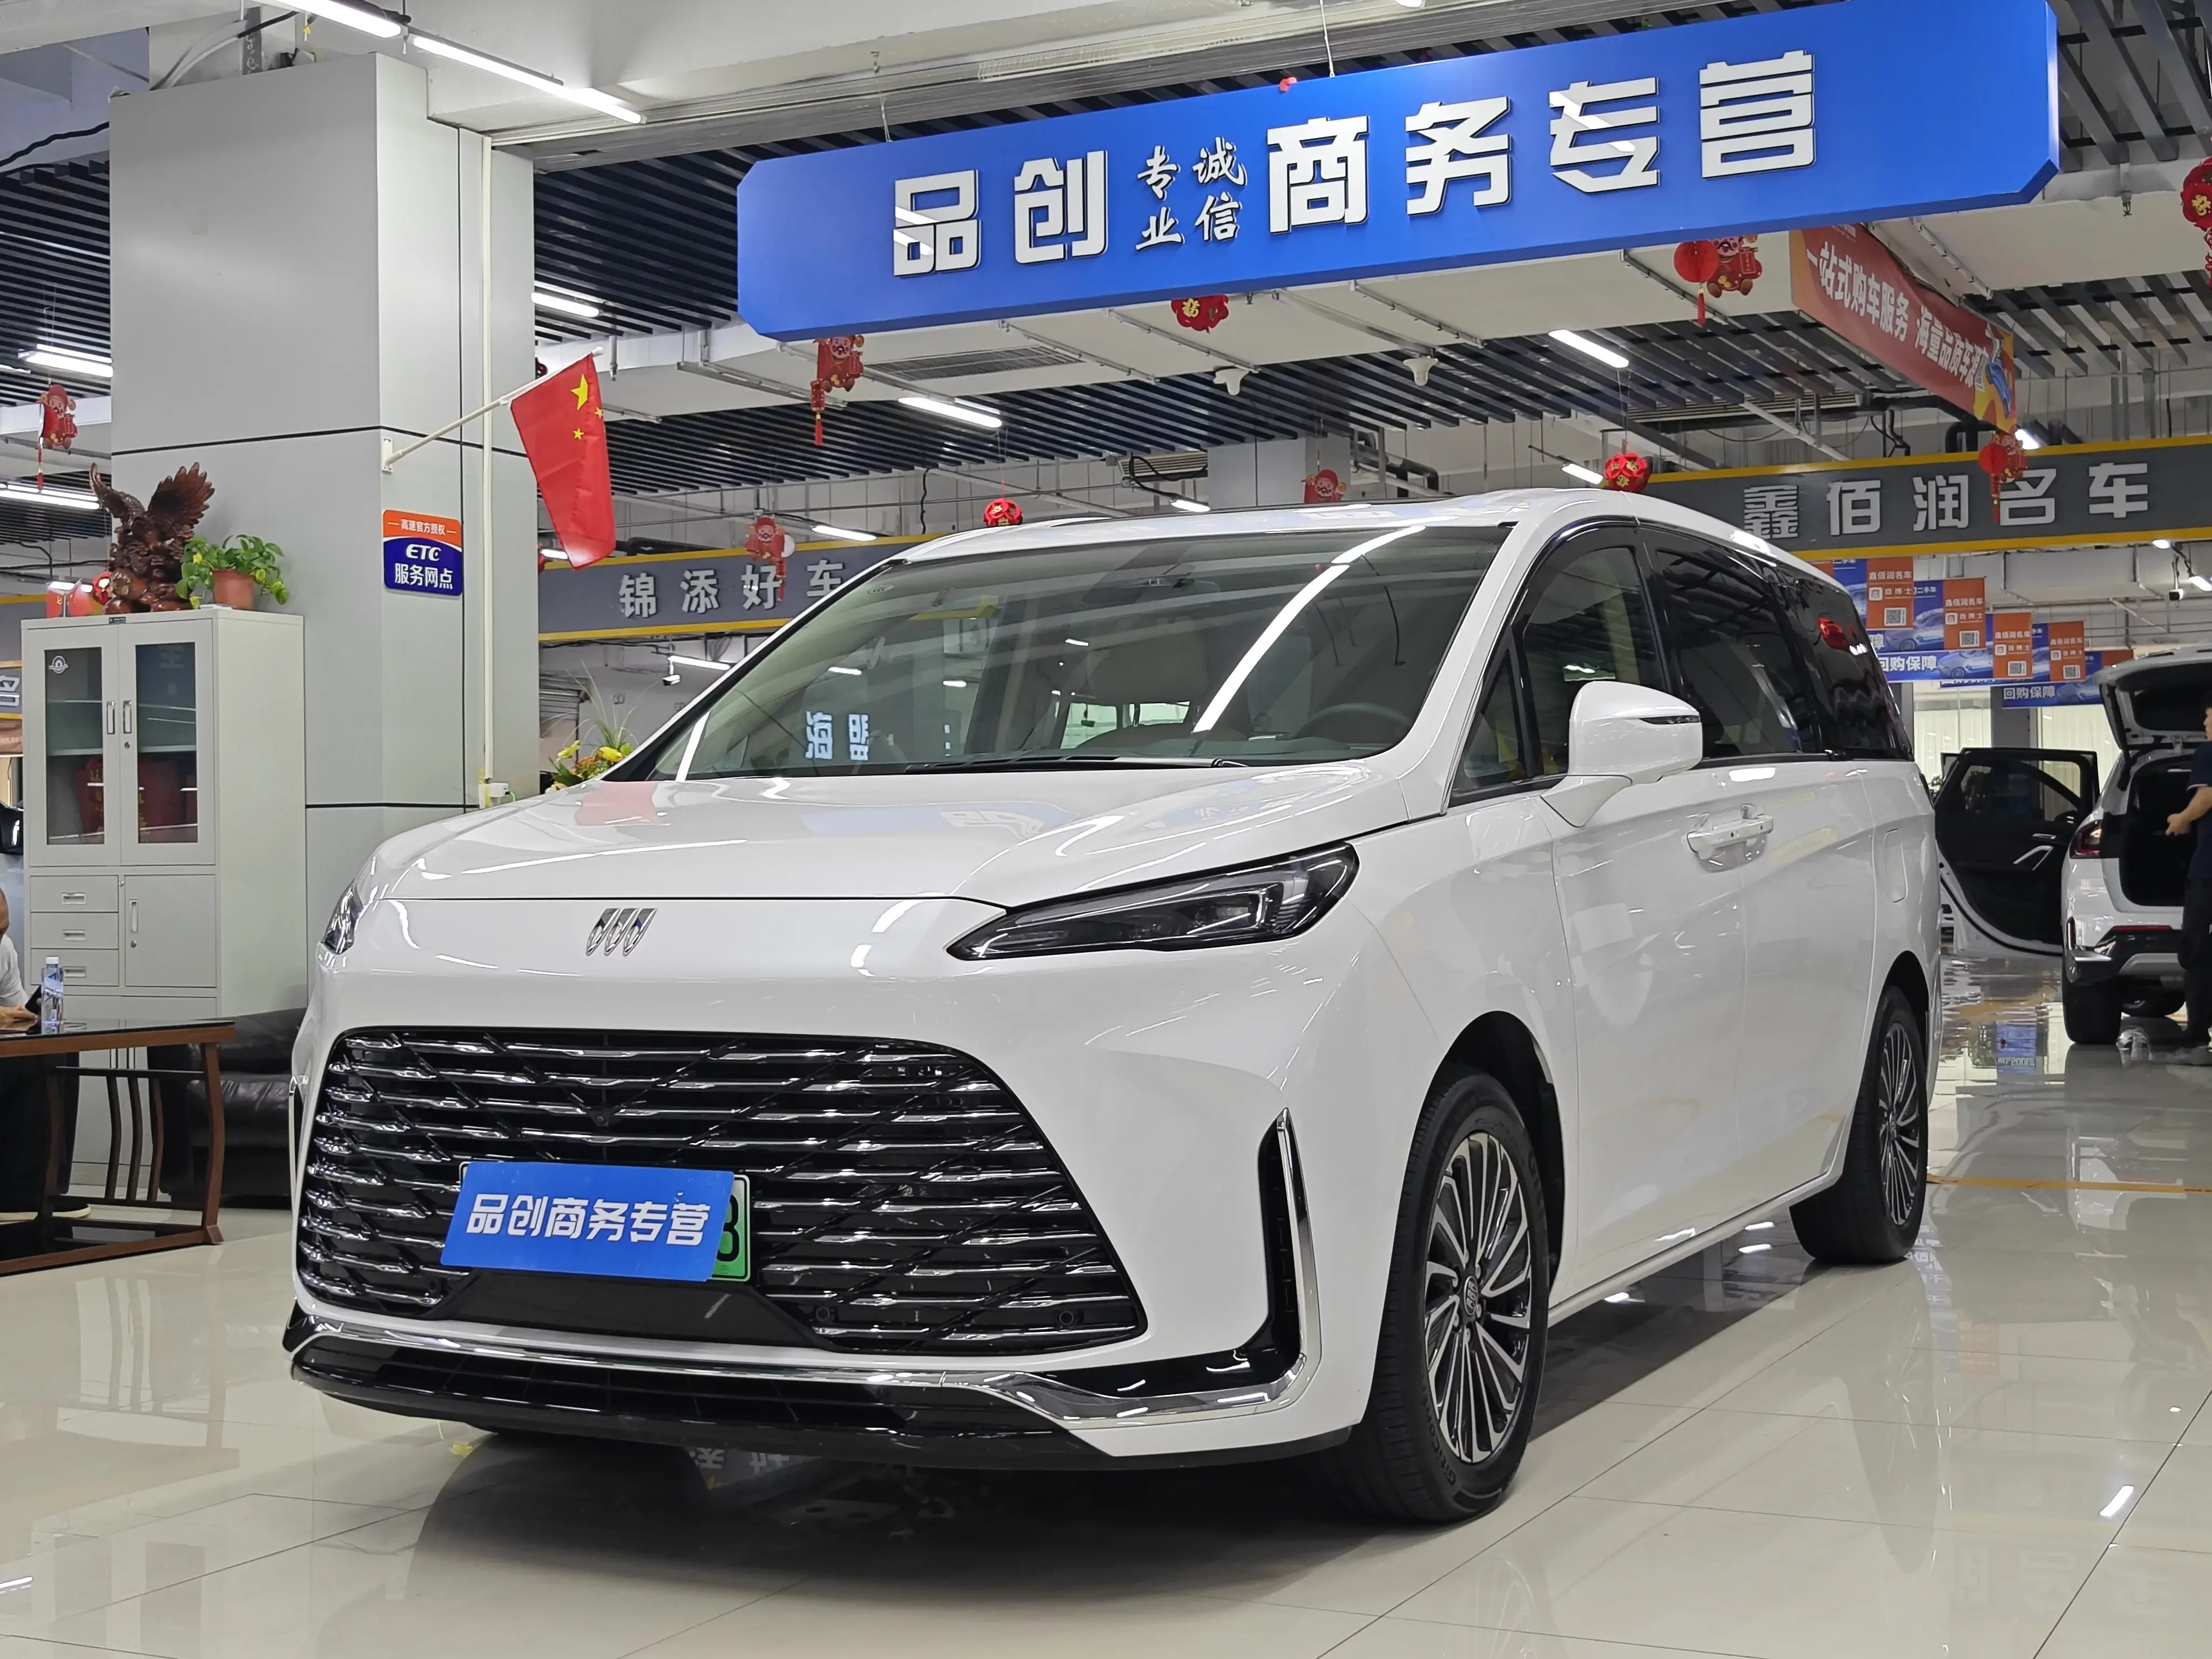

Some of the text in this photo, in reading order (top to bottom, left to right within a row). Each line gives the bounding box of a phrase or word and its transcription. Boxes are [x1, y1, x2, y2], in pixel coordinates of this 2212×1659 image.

[893, 49, 1815, 277] 品创 商务专营
[1806, 241, 1910, 342] 一站式购车服务
[1743, 462, 2149, 539] 鑫佰润名车
[400, 519, 446, 535] 高速官方授权
[406, 544, 441, 561] ETC
[395, 563, 453, 590] 服务网点
[618, 559, 844, 618] 锦添好车
[1913, 586, 1937, 595] 二手车
[1878, 655, 1937, 672] 回购保障
[2004, 685, 2055, 700] 回购保障
[466, 1192, 711, 1246] 品创商务专营
